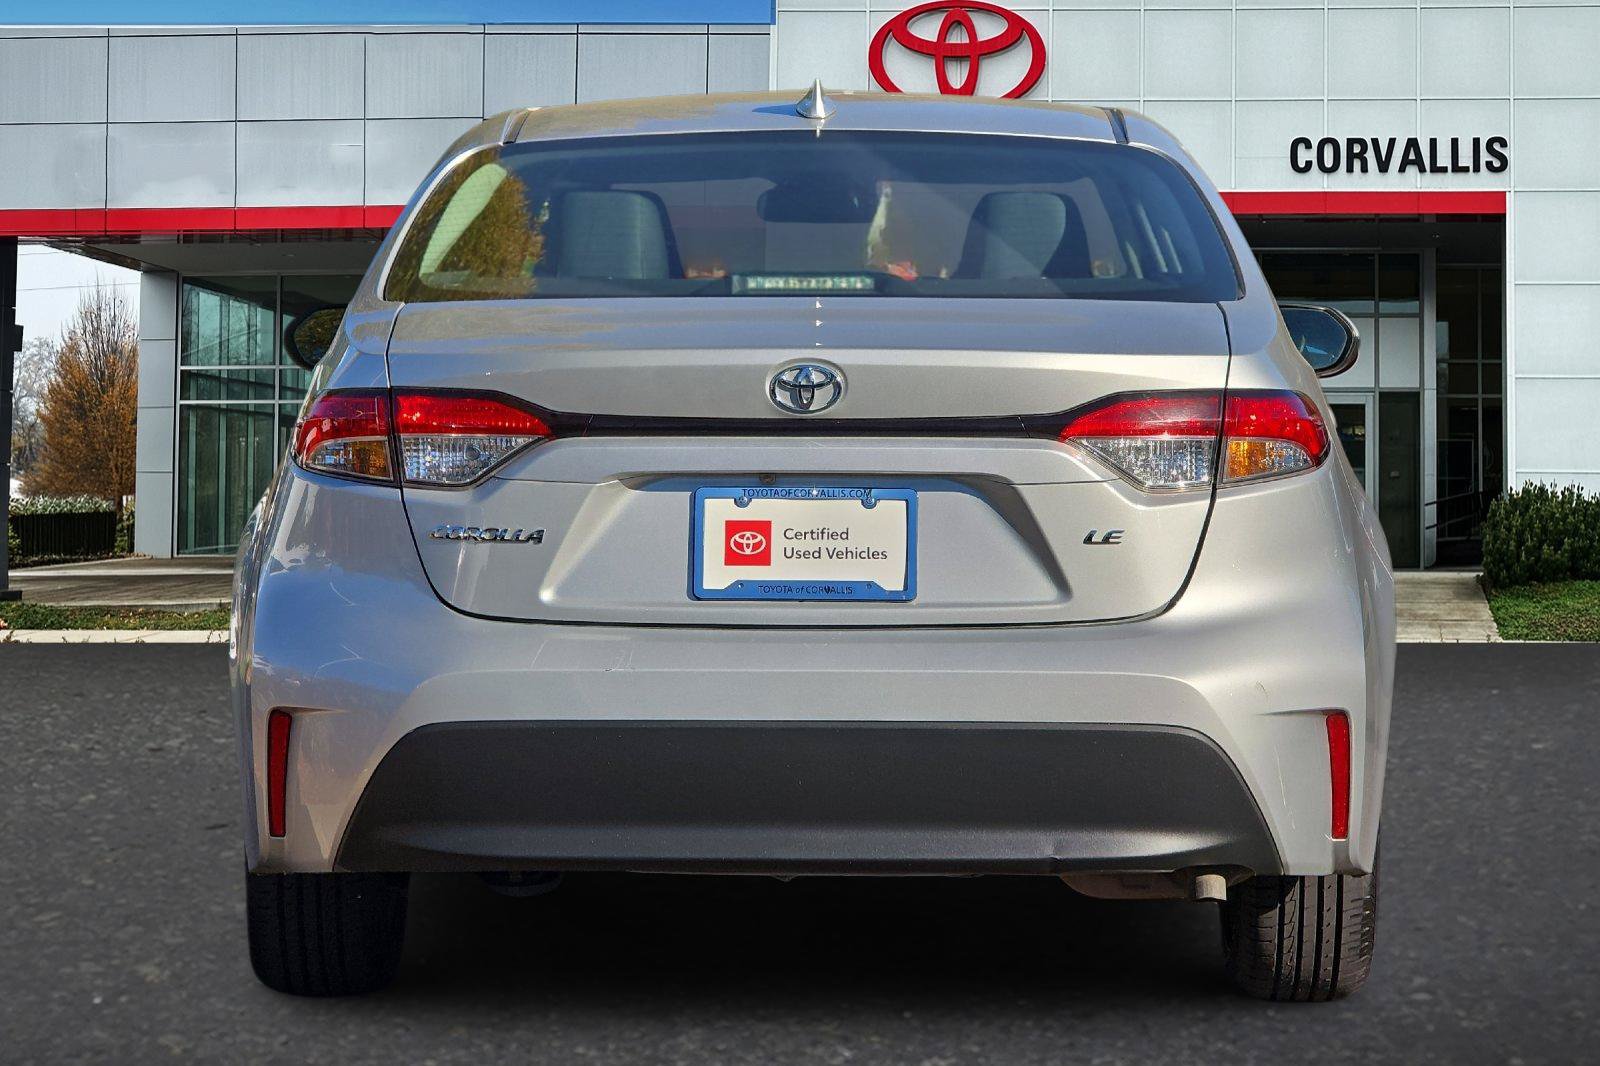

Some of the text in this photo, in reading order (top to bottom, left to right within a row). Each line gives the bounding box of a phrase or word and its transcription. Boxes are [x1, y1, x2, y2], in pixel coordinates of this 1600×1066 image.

[1290, 136, 1509, 174] CORVALLIS
[429, 525, 547, 545] COROLLA
[783, 527, 849, 540] Certified
[1083, 528, 1126, 545] LE
[783, 546, 888, 560] Used Vehicles
[758, 584, 854, 596] TOYOTA of CORVALLIS
